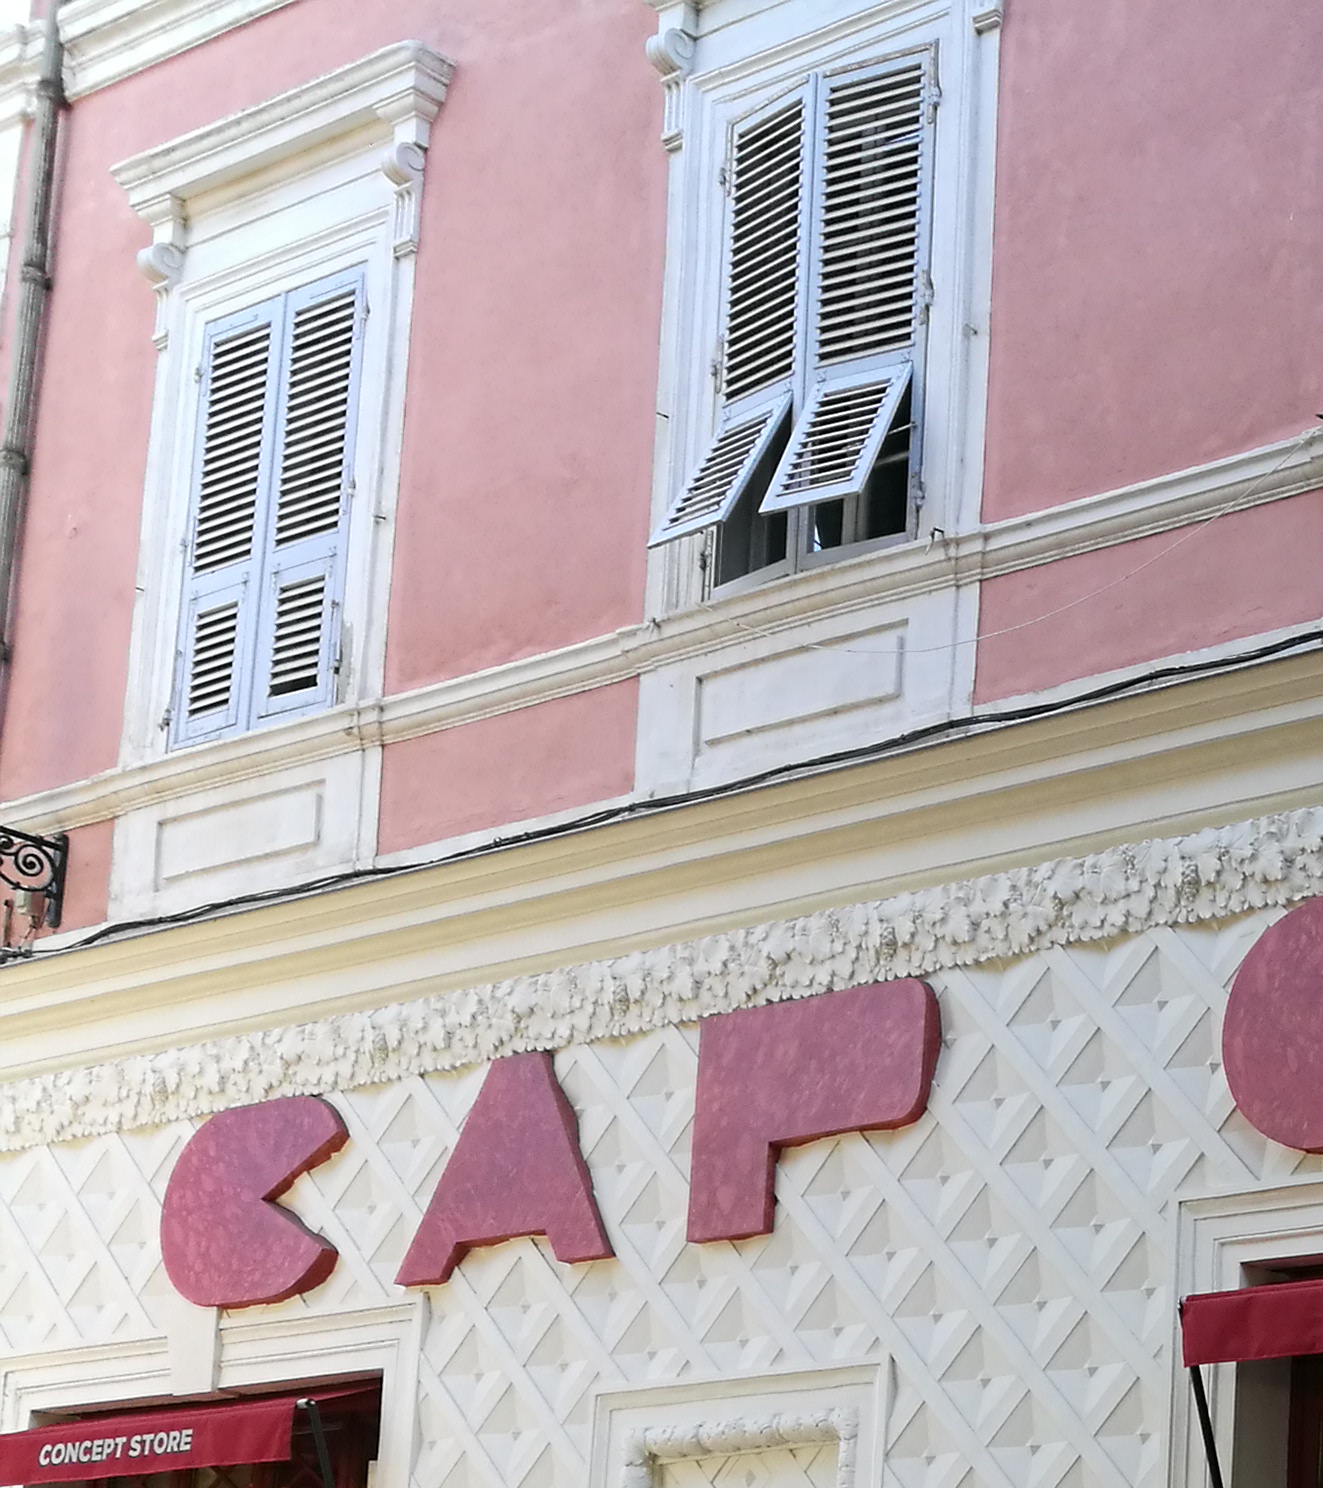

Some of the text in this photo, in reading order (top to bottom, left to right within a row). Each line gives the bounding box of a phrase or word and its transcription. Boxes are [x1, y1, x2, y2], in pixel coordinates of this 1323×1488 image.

[160, 977, 943, 1311] CAP
[39, 1429, 193, 1467] CONCEPT STORE
